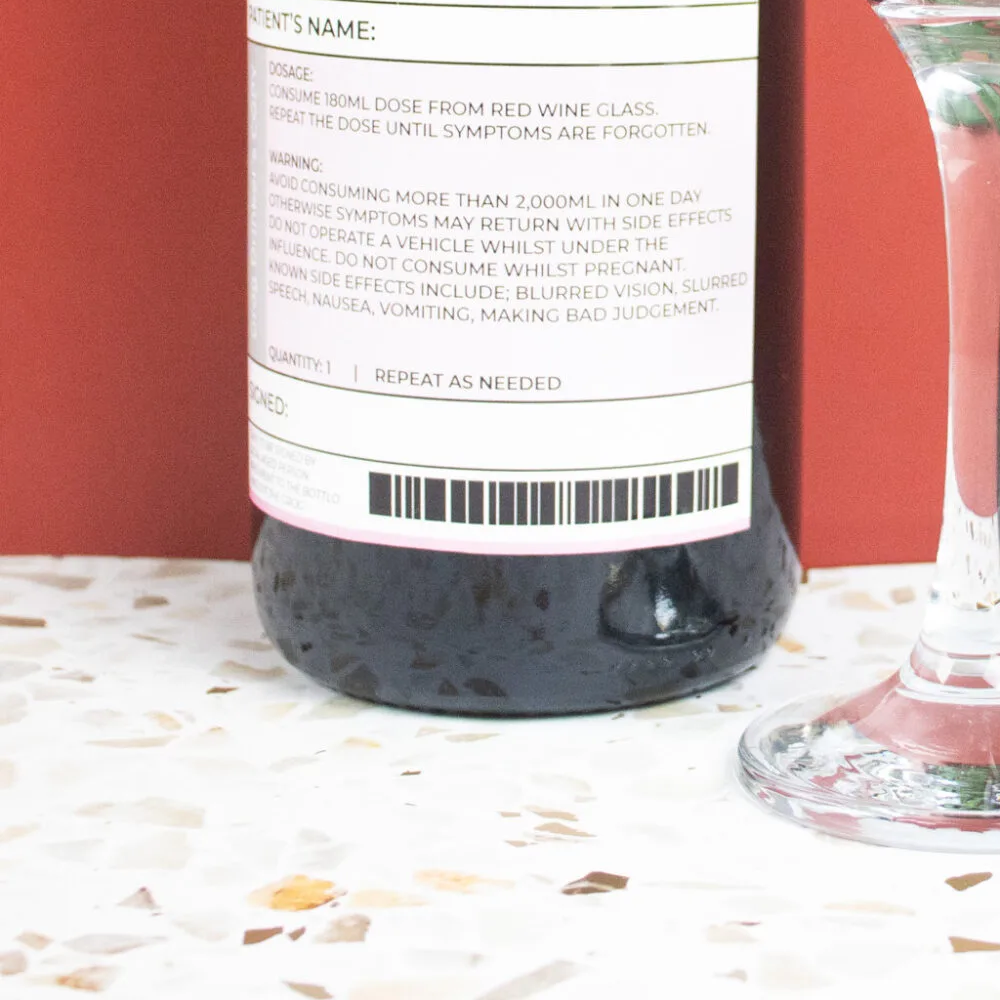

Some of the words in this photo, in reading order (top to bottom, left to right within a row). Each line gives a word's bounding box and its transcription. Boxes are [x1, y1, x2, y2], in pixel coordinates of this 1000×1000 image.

[308, 16, 375, 40] NAME:
[269, 60, 314, 82] DOSAGE:
[269, 83, 321, 105] CONSUME
[325, 92, 369, 110] 180ML
[375, 97, 423, 114] DOSE
[429, 100, 484, 116] FROM
[491, 102, 532, 117] RED
[538, 102, 591, 118] WINE
[597, 101, 659, 117] GLASS.
[269, 105, 305, 125] REPEAT
[309, 113, 334, 129] THE
[338, 116, 381, 134] DOSE
[386, 120, 438, 138] UNTIL
[443, 123, 552, 141] SYMPTOMS
[558, 125, 597, 141] ARE
[602, 121, 710, 141] FORGOTTEN.
[269, 150, 323, 173] WARNING:
[269, 171, 298, 191] AVOID
[300, 178, 390, 203] CONSUMING
[395, 190, 450, 206] MORE
[455, 192, 509, 208] THAN
[515, 194, 597, 212] 2,000ML
[602, 194, 620, 208] IN
[626, 191, 665, 208] ONE
[670, 188, 702, 205] DAY
[269, 193, 333, 219] OTHERWISE
[336, 206, 429, 229] SYMPTOMS
[434, 215, 475, 231] MAY
[480, 216, 560, 232] RETURN
[566, 216, 616, 232] WITH
[622, 214, 662, 230] SIDE
[668, 208, 733, 228] EFFECTS
[269, 215, 282, 229] DO
[284, 220, 307, 237] NOT
[309, 224, 376, 247] OPERATE
[380, 234, 392, 248] A
[396, 235, 475, 254] VEHICLE
[480, 239, 556, 255] WHILST
[561, 238, 630, 255] UNDER
[635, 236, 669, 252] THE
[269, 237, 331, 263] INFLUENCE.
[335, 251, 358, 267] DO
[363, 255, 397, 271] NOT
[402, 257, 498, 277] CONSUME
[504, 262, 578, 278] WHILST
[584, 257, 686, 277] PREGNANT.
[269, 261, 307, 281] KNOWN
[310, 269, 341, 288] SIDE
[345, 274, 415, 296] EFFECTS
[420, 282, 510, 301] INCLUDE;
[516, 284, 609, 301] BLURRED
[613, 281, 678, 299] VISION,
[682, 272, 748, 294] SLURRED
[312, 292, 375, 316] NAUSEA,
[380, 302, 474, 324] VOMITING,
[480, 307, 560, 323] MAKING
[566, 307, 607, 323] BAD
[612, 298, 719, 321] JUDGEMENT.
[268, 345, 322, 373] QUANTITY:
[375, 368, 443, 388] REPEAT
[449, 374, 473, 390] AS
[479, 376, 562, 391] NEEDED
